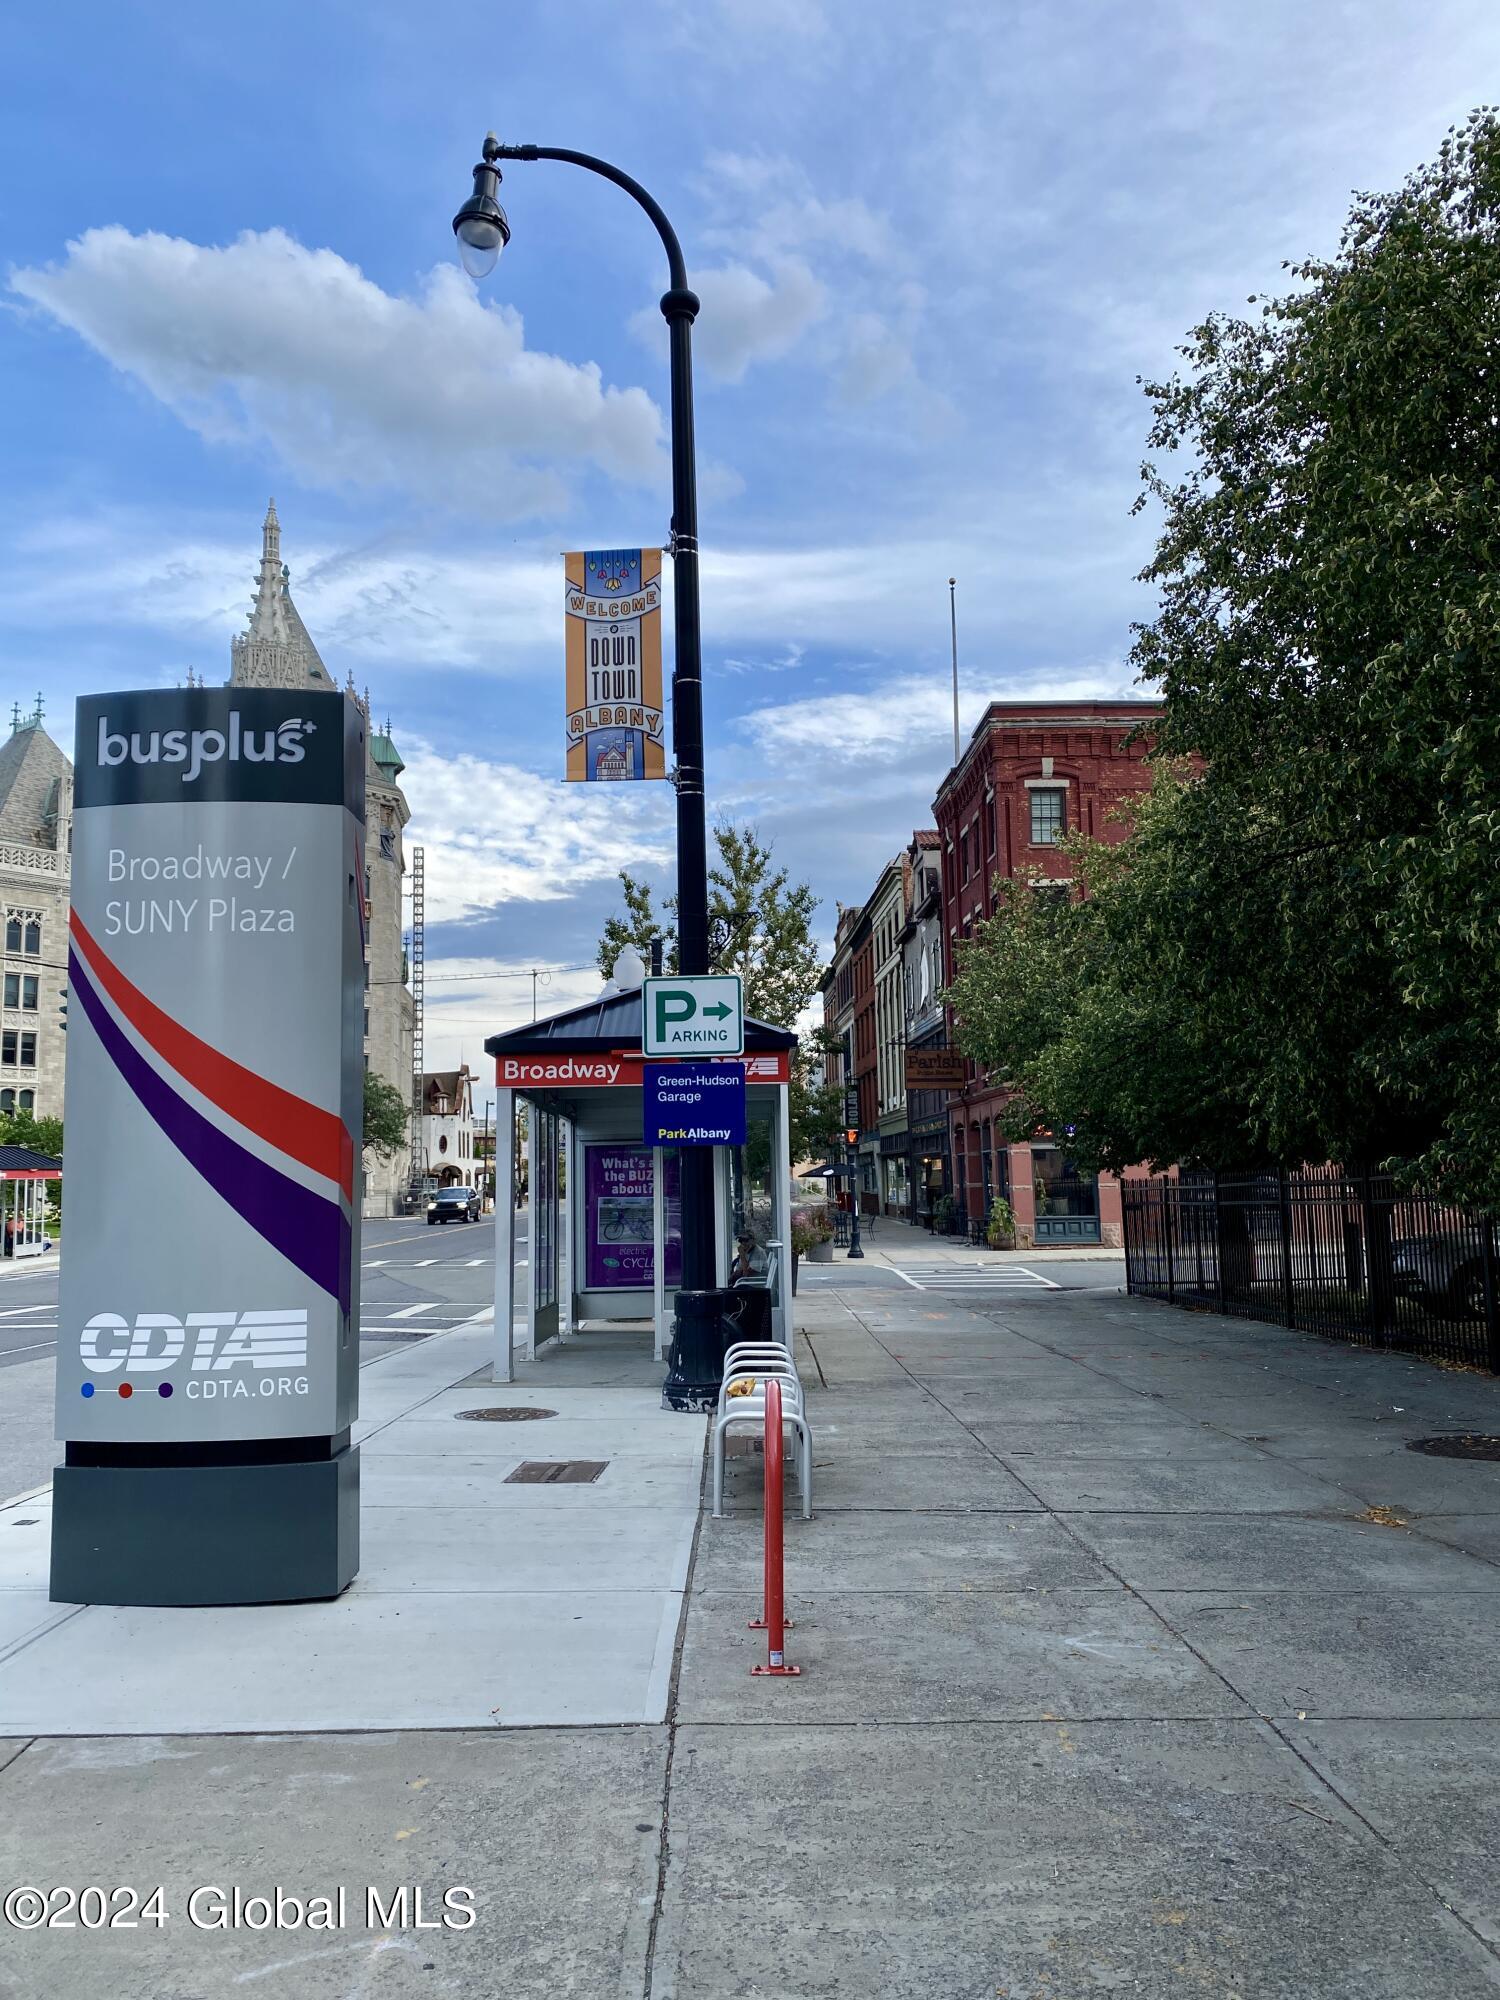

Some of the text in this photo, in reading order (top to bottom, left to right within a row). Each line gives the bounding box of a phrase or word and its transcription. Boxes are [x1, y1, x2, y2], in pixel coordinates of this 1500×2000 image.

[570, 591, 657, 617] WELCOME
[591, 636, 636, 667] DOWN
[591, 669, 637, 701] TOWN
[570, 706, 661, 733] ALBANY
[108, 844, 273, 889] Broadway
[104, 896, 296, 935] SUNY Plaza
[504, 1057, 620, 1084] Broadway
[907, 1054, 963, 1069] Parish
[657, 1075, 740, 1087] Green-Hudson
[657, 1090, 702, 1104] Garage
[602, 1157, 646, 1169] What's
[605, 1171, 655, 1181] the BUZ
[612, 1183, 655, 1194] about?
[79, 1308, 308, 1374] CDTA
[185, 1377, 310, 1400] CDTA.ORG
